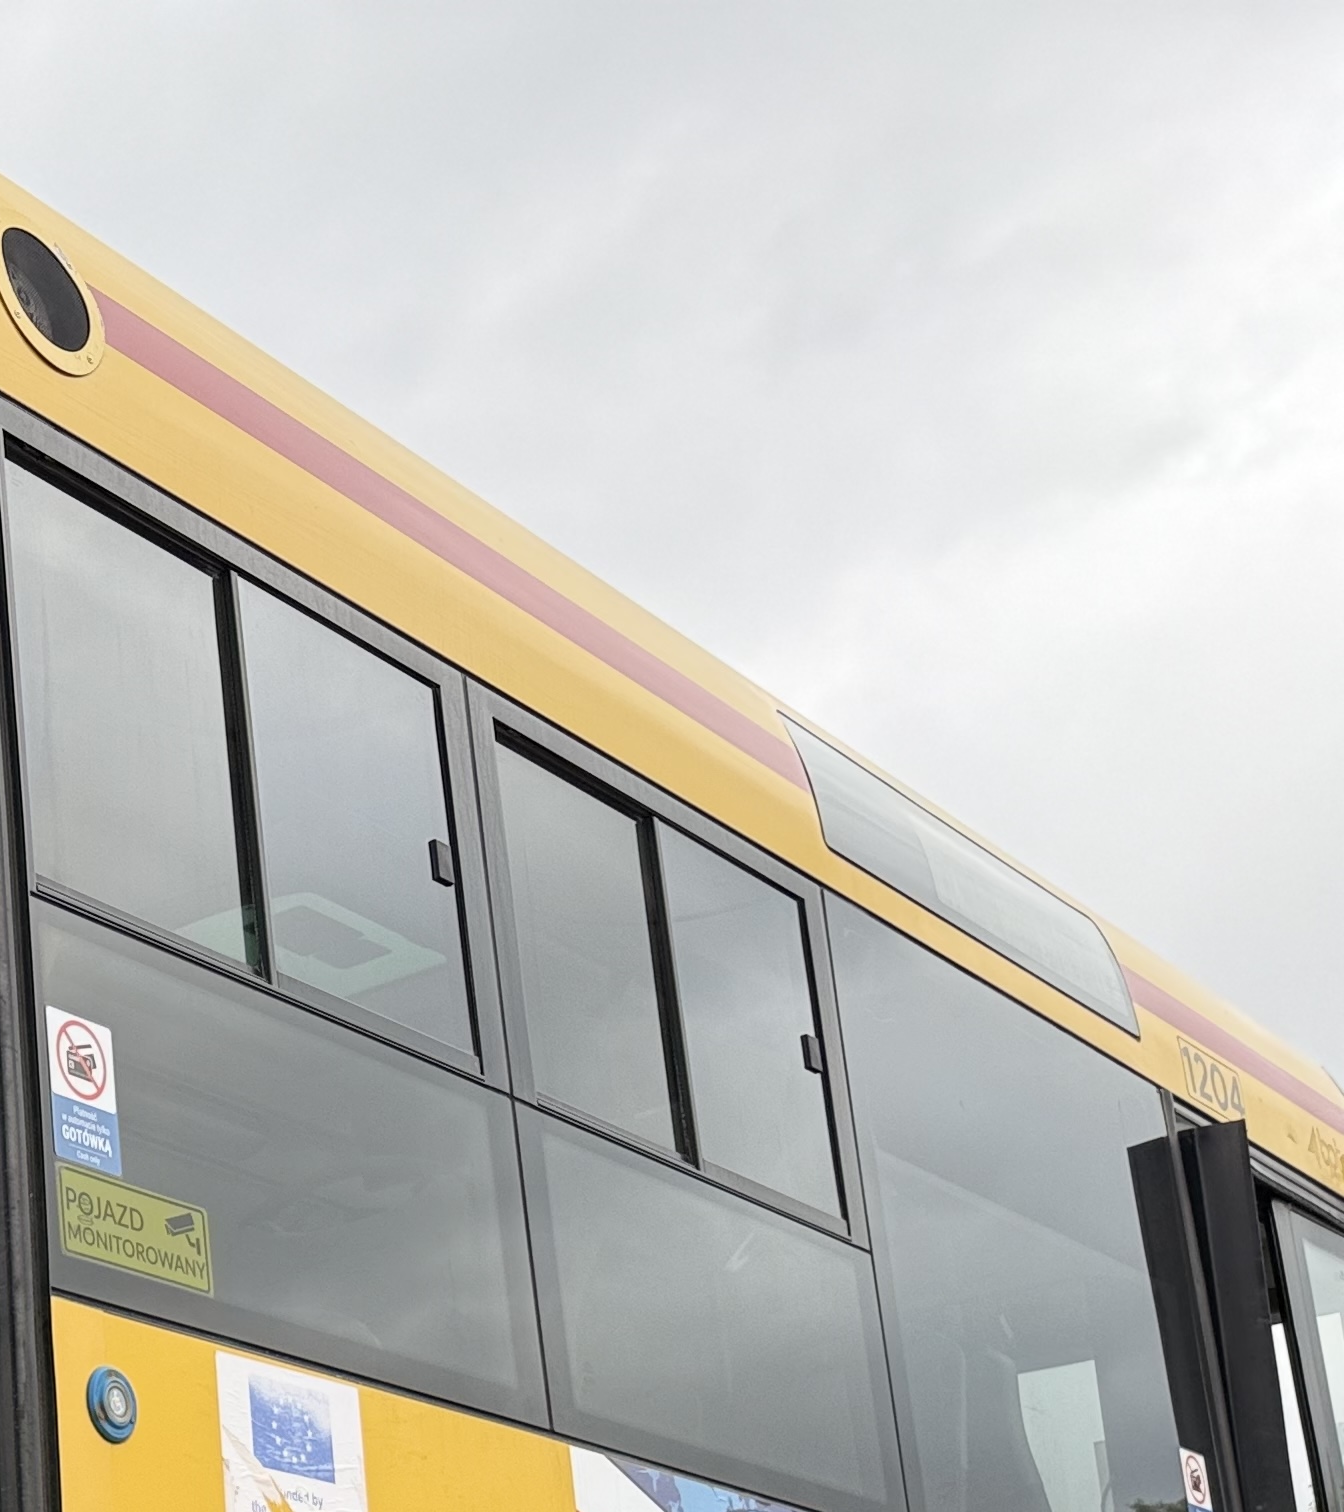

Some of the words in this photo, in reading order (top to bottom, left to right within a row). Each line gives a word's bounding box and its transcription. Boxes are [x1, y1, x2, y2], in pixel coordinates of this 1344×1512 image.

[1181, 1046, 1245, 1117] 1204
[65, 1187, 144, 1231] POJAZD
[68, 1221, 205, 1280] MONITOROWANY
